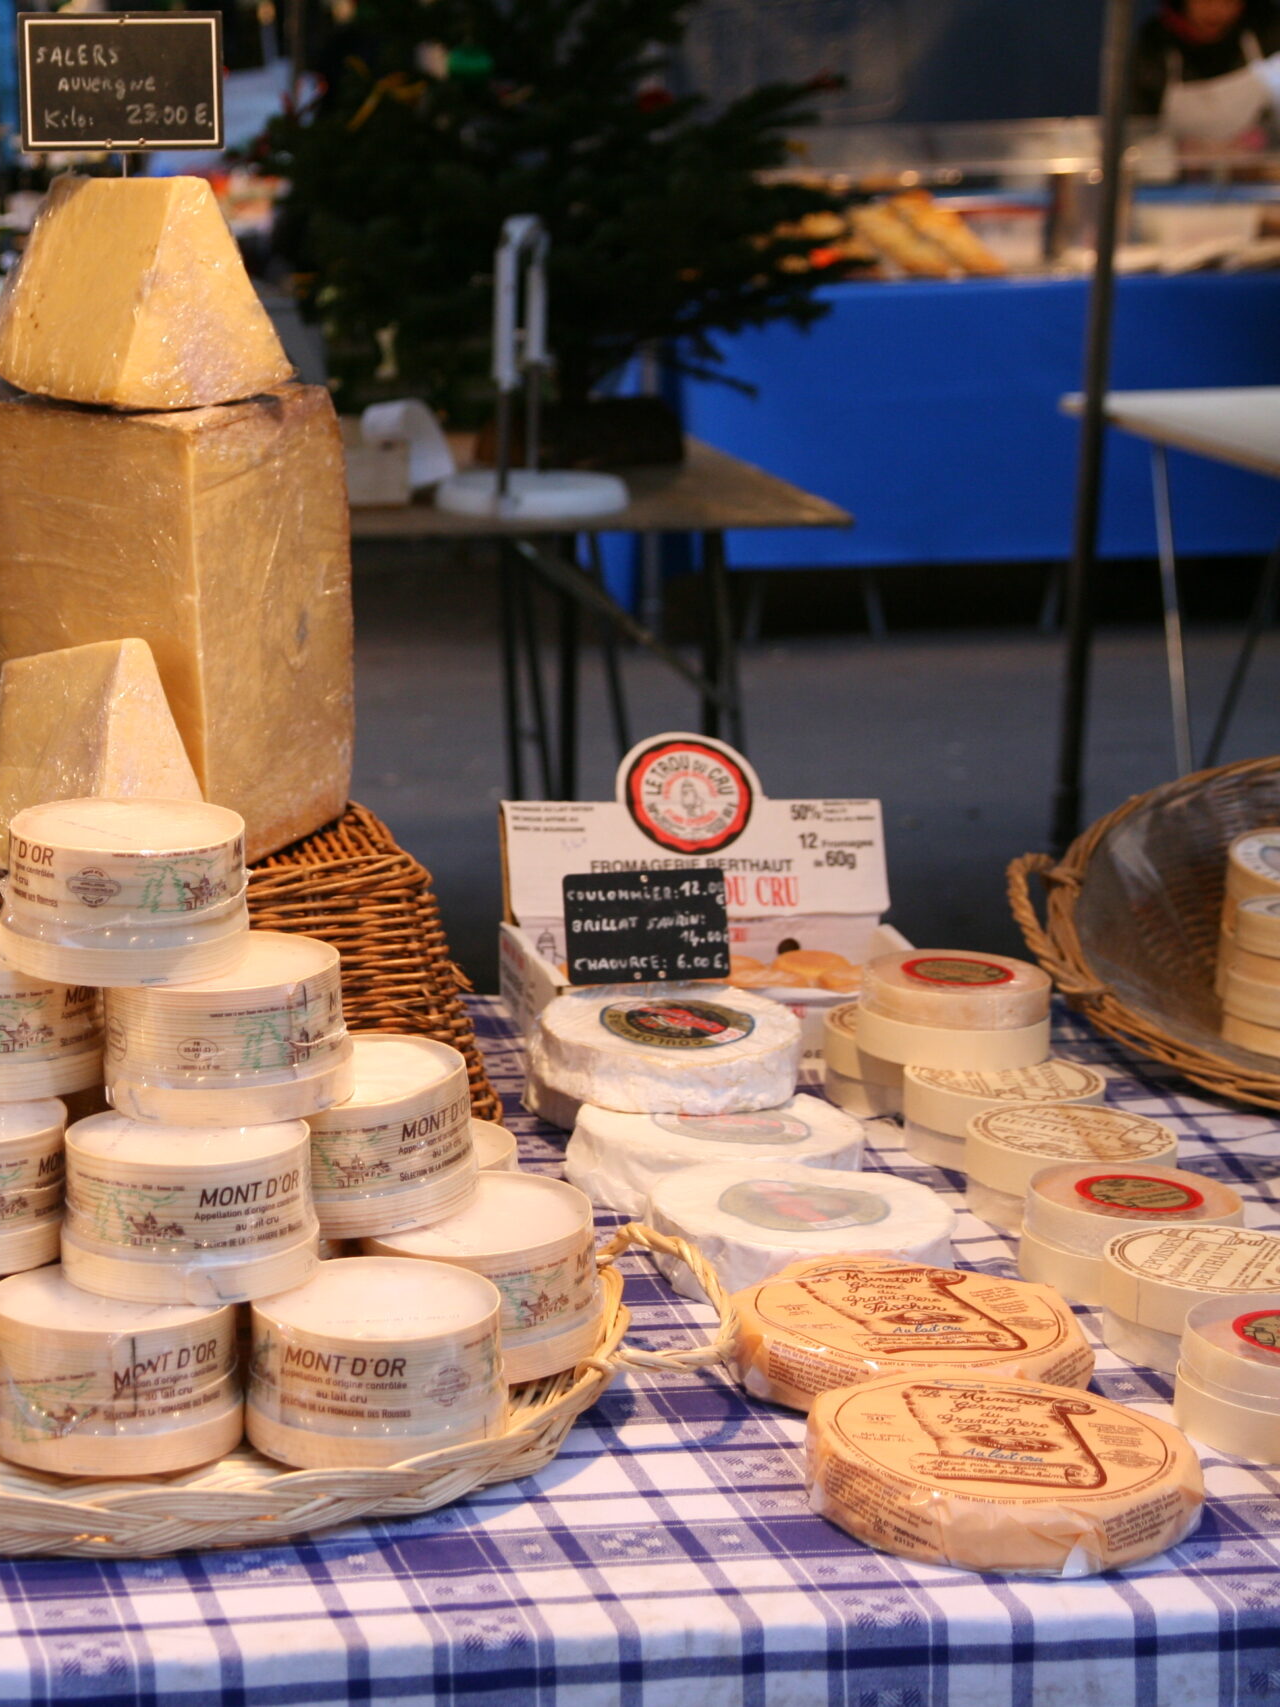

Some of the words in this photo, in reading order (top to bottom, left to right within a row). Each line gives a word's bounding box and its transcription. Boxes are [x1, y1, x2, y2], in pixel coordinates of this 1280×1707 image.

[35, 43, 119, 67] SALERS
[651, 754, 690, 779] TROU
[708, 766, 735, 796] CRU
[791, 803, 822, 822] 50%
[798, 832, 818, 849] 12
[18, 840, 55, 867] D'OR
[825, 850, 857, 870] 60g
[590, 859, 700, 873] FROMAGERIE
[706, 859, 793, 872] BERTHAUT
[756, 876, 799, 908] CRU
[572, 915, 639, 933] BRILLAT
[64, 986, 98, 1007] MON
[401, 1110, 448, 1142] MONT
[198, 1181, 262, 1208] MONT
[265, 1169, 299, 1199] D'OR
[194, 1210, 242, 1221] Appellation
[244, 1203, 275, 1217] d'origine
[235, 1223, 246, 1231] au
[266, 1216, 280, 1226] cru
[1188, 1245, 1238, 1285] BERTHAUT
[838, 1272, 923, 1284] Munster
[863, 1300, 948, 1315] Fischer
[893, 1326, 912, 1334] Au
[914, 1324, 938, 1333] lait
[942, 1324, 963, 1332] cru
[114, 1351, 173, 1393] MONT
[176, 1338, 217, 1369] D'OR
[284, 1345, 346, 1374] MONT
[351, 1357, 407, 1378] D'OR
[154, 1372, 188, 1386] d'origine
[280, 1366, 323, 1384] Appellation
[325, 1376, 363, 1390] d'origine
[365, 1379, 408, 1390] contrôlée
[160, 1388, 176, 1400] lait
[178, 1385, 192, 1397] cru
[316, 1391, 328, 1399] au
[330, 1390, 347, 1403] lait
[349, 1393, 368, 1404] cru
[949, 1391, 1046, 1407] Munster
[308, 1403, 316, 1411] DE
[318, 1404, 325, 1413] LA
[327, 1406, 365, 1418] FROMAGERIE
[950, 1424, 1047, 1437] Fischer
[963, 1448, 986, 1457] Au
[988, 1448, 1019, 1460] lait
[1019, 1455, 1044, 1463] cru
